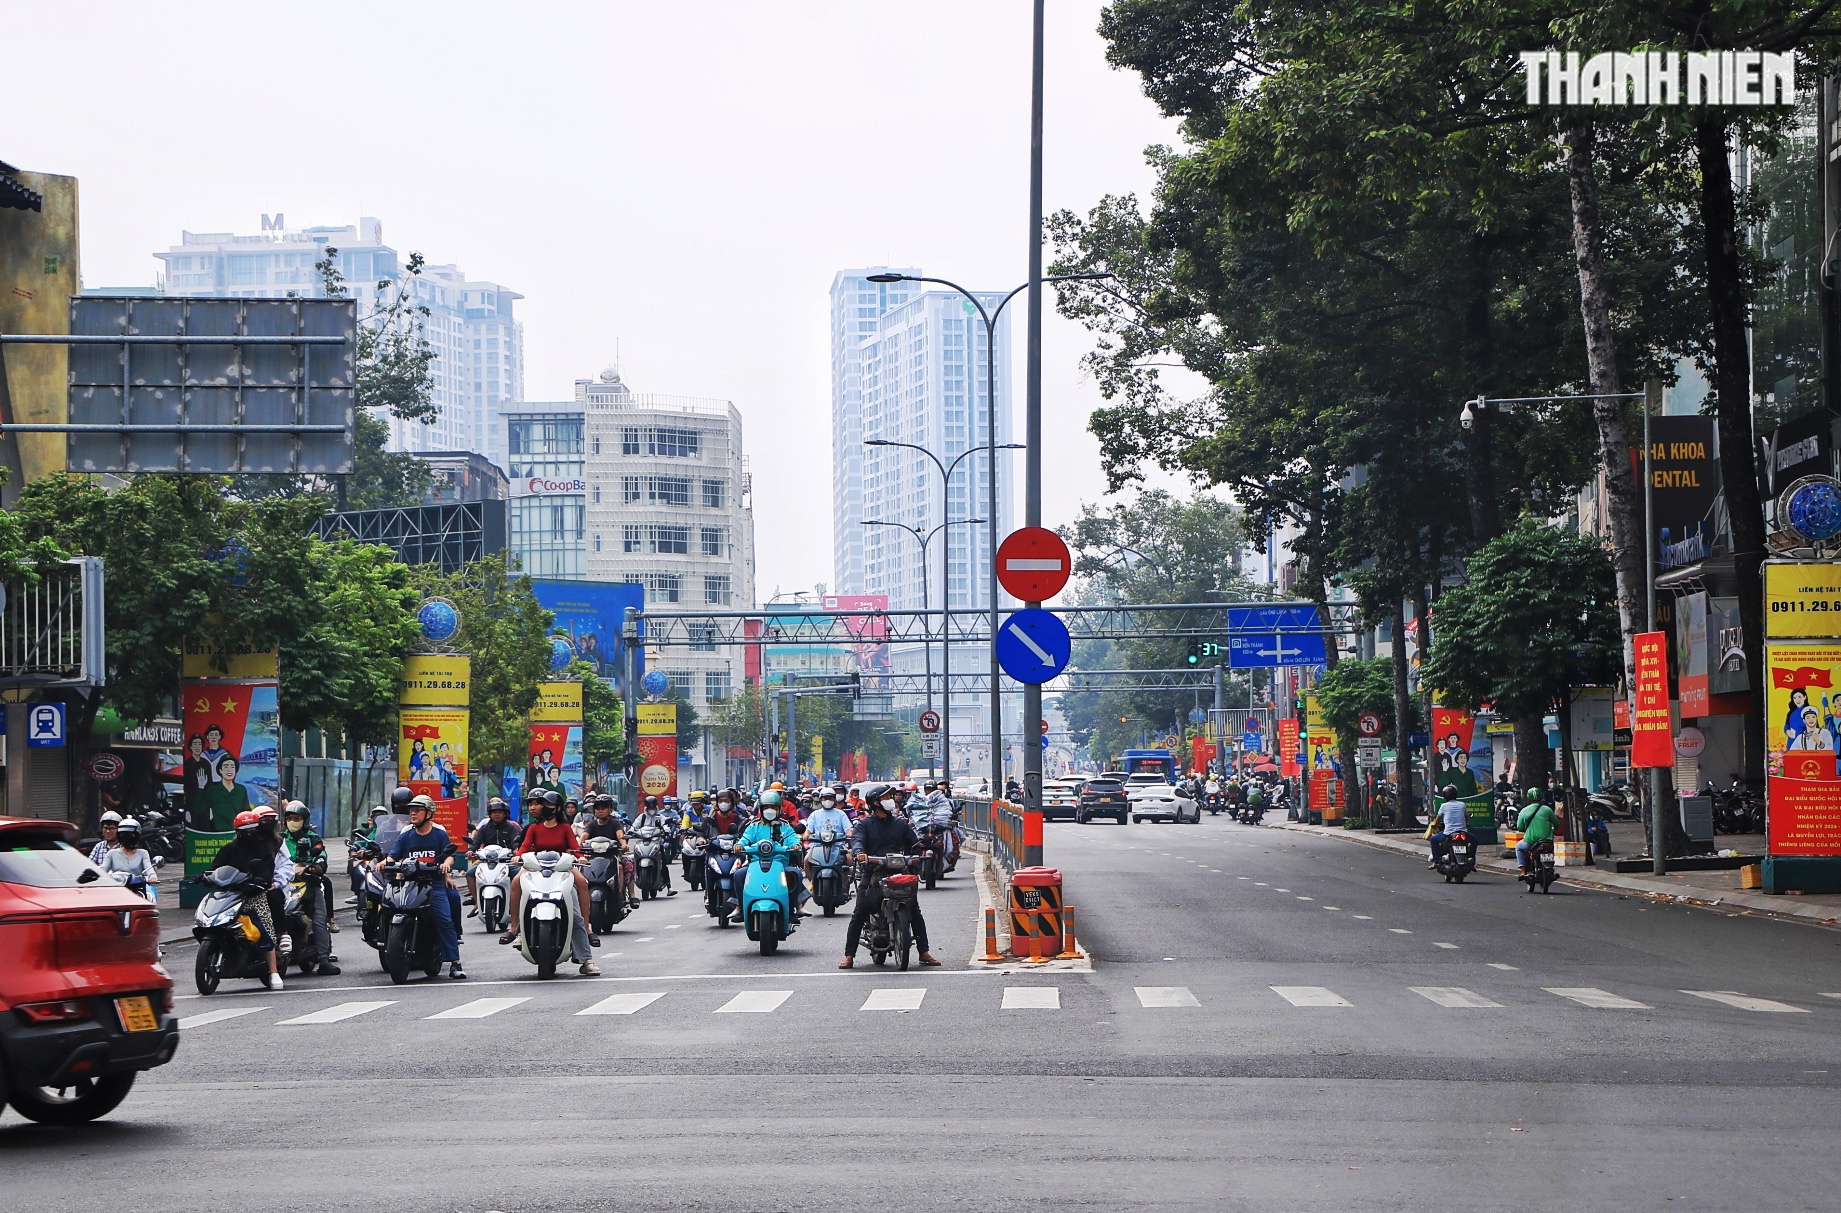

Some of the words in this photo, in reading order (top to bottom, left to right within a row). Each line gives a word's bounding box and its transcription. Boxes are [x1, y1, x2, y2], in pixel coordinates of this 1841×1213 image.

[261, 213, 284, 231] M
[1670, 442, 1706, 460] KHOA
[1646, 469, 1700, 489] ENTAL
[1815, 586, 1823, 594] HỆ
[1202, 642, 1218, 656] 37
[402, 680, 466, 690] 0911.29.68.28
[160, 727, 181, 742] COFFEE
[194, 839, 208, 847] THANH
